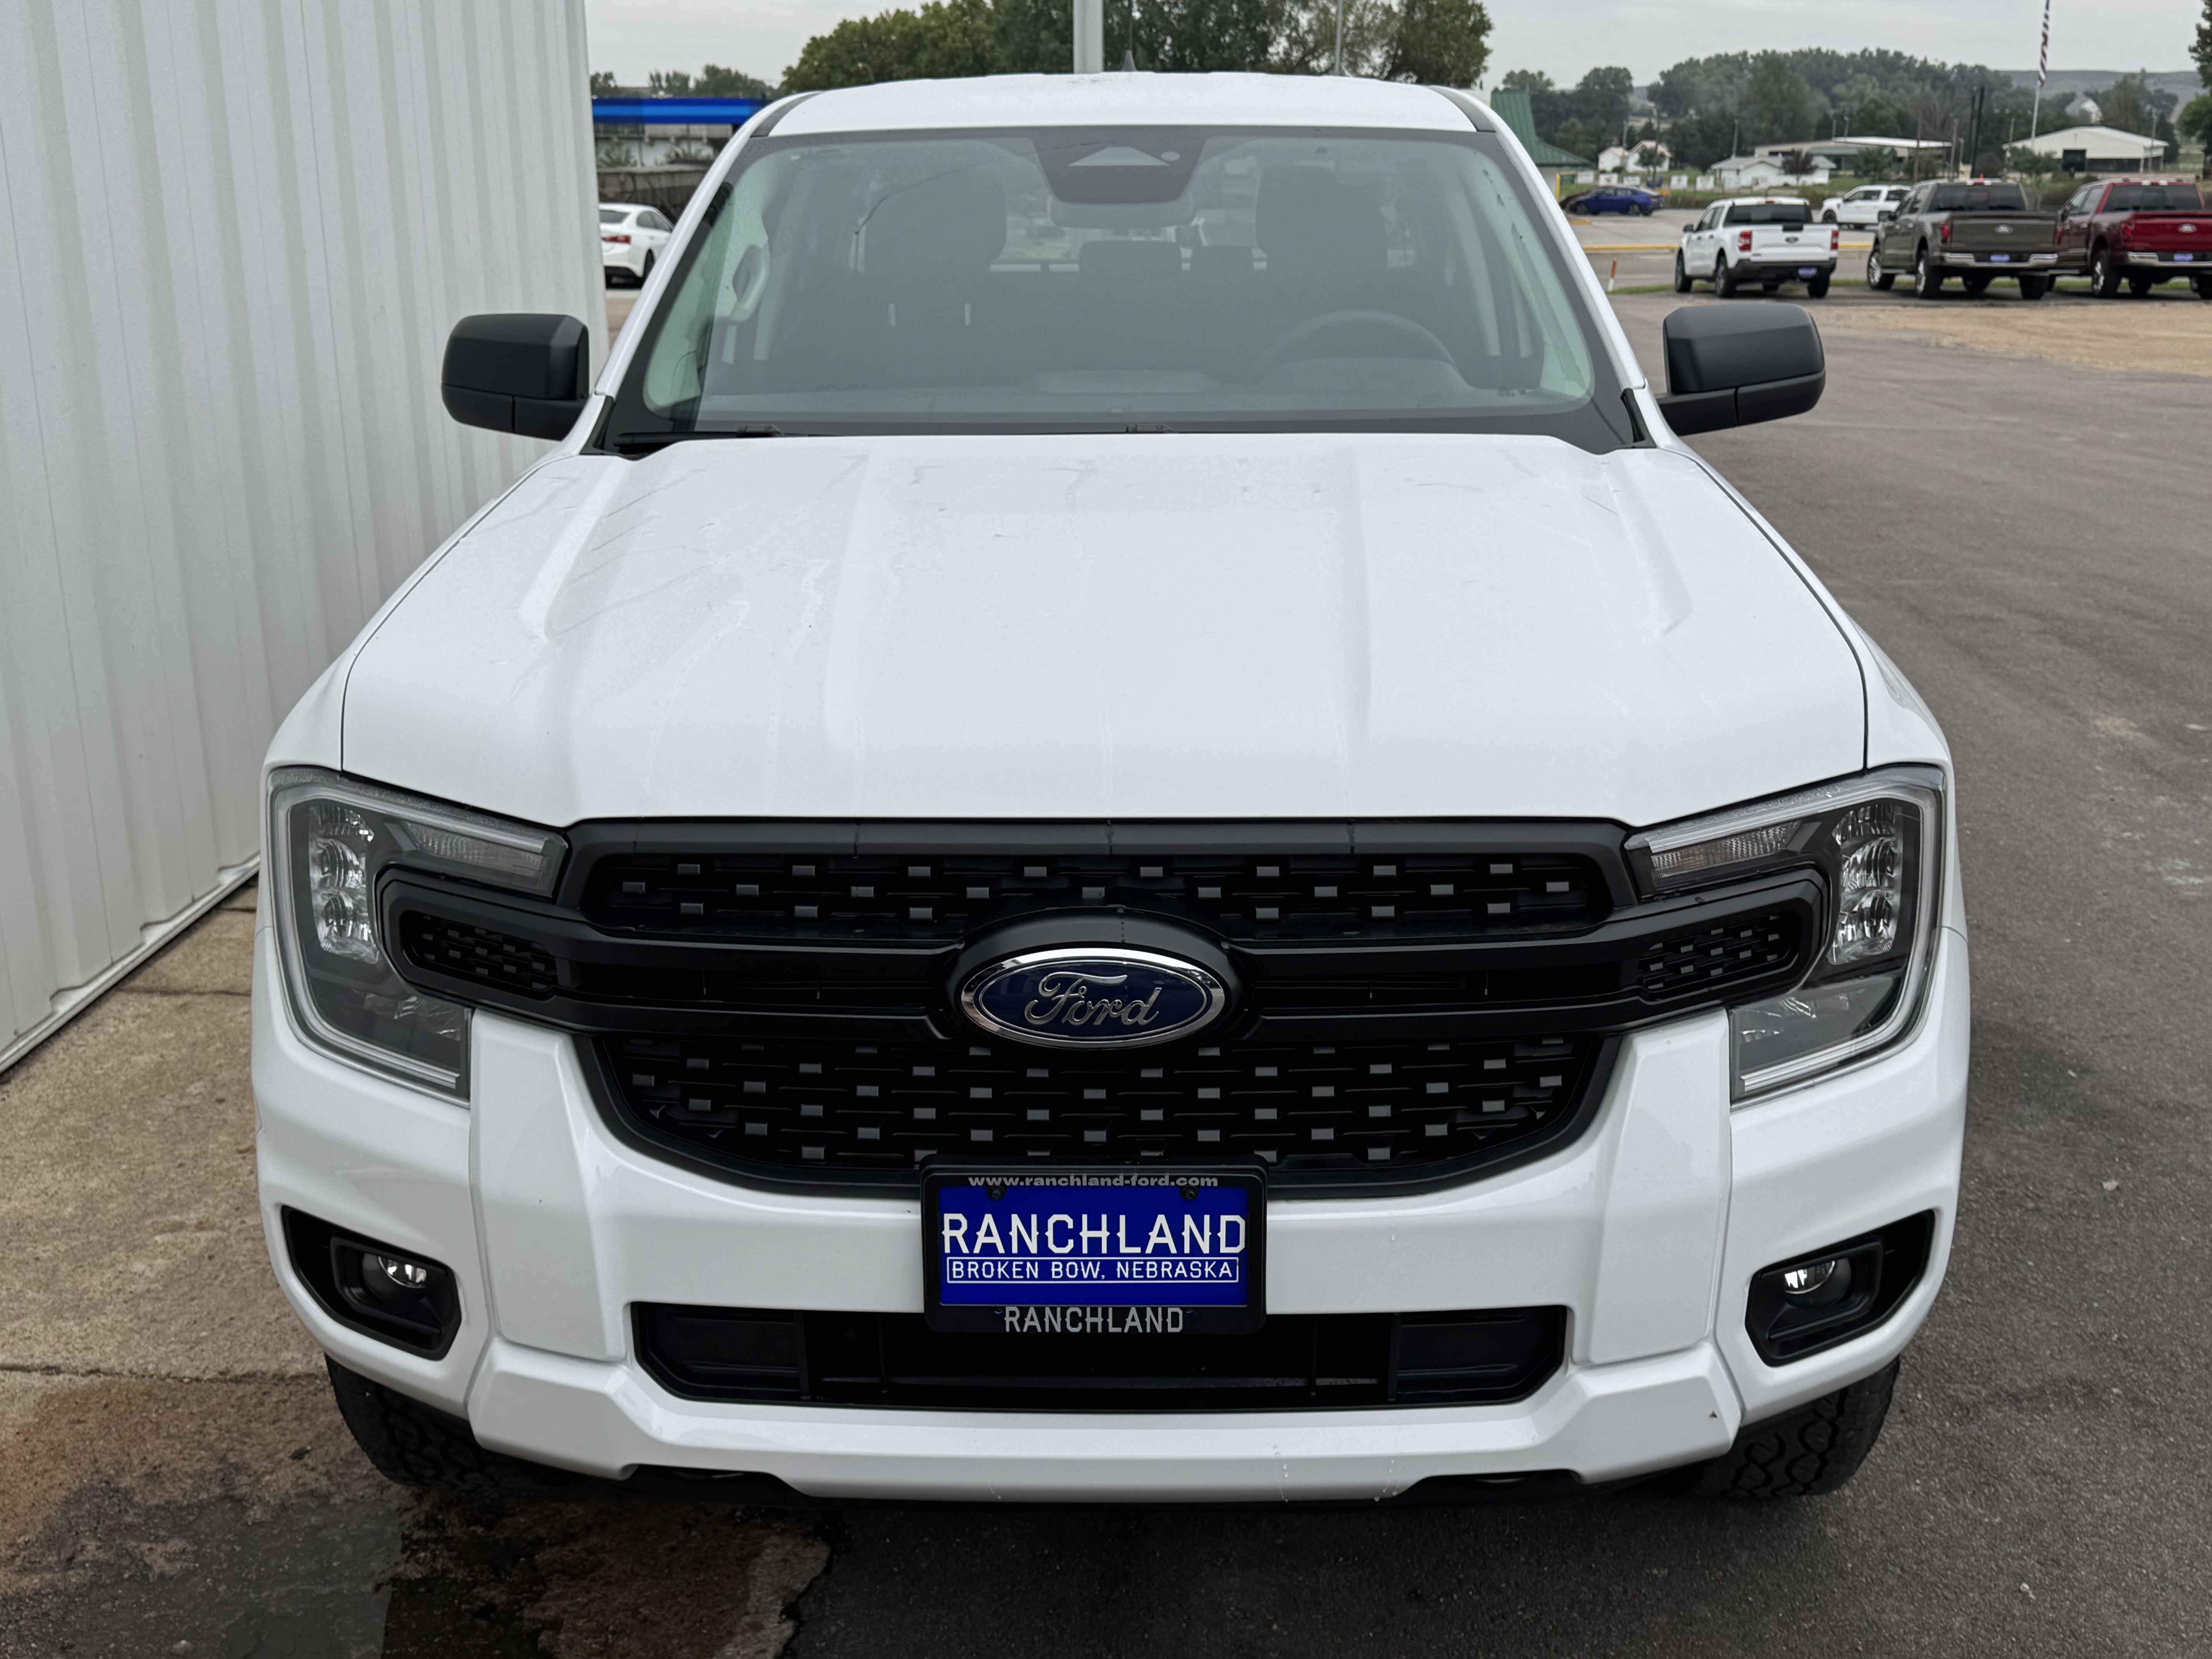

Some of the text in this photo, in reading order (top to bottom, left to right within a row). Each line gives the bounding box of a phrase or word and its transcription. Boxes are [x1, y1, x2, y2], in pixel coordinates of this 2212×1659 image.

[1024, 971, 1162, 1025] Ford
[968, 1173, 1218, 1187] www.ranchland-ford.com
[941, 1213, 1245, 1254] RANCHLAND
[952, 1261, 1233, 1280] BROKEN BOW, NEBRASKA
[1004, 1306, 1183, 1333] RANCHLAND
